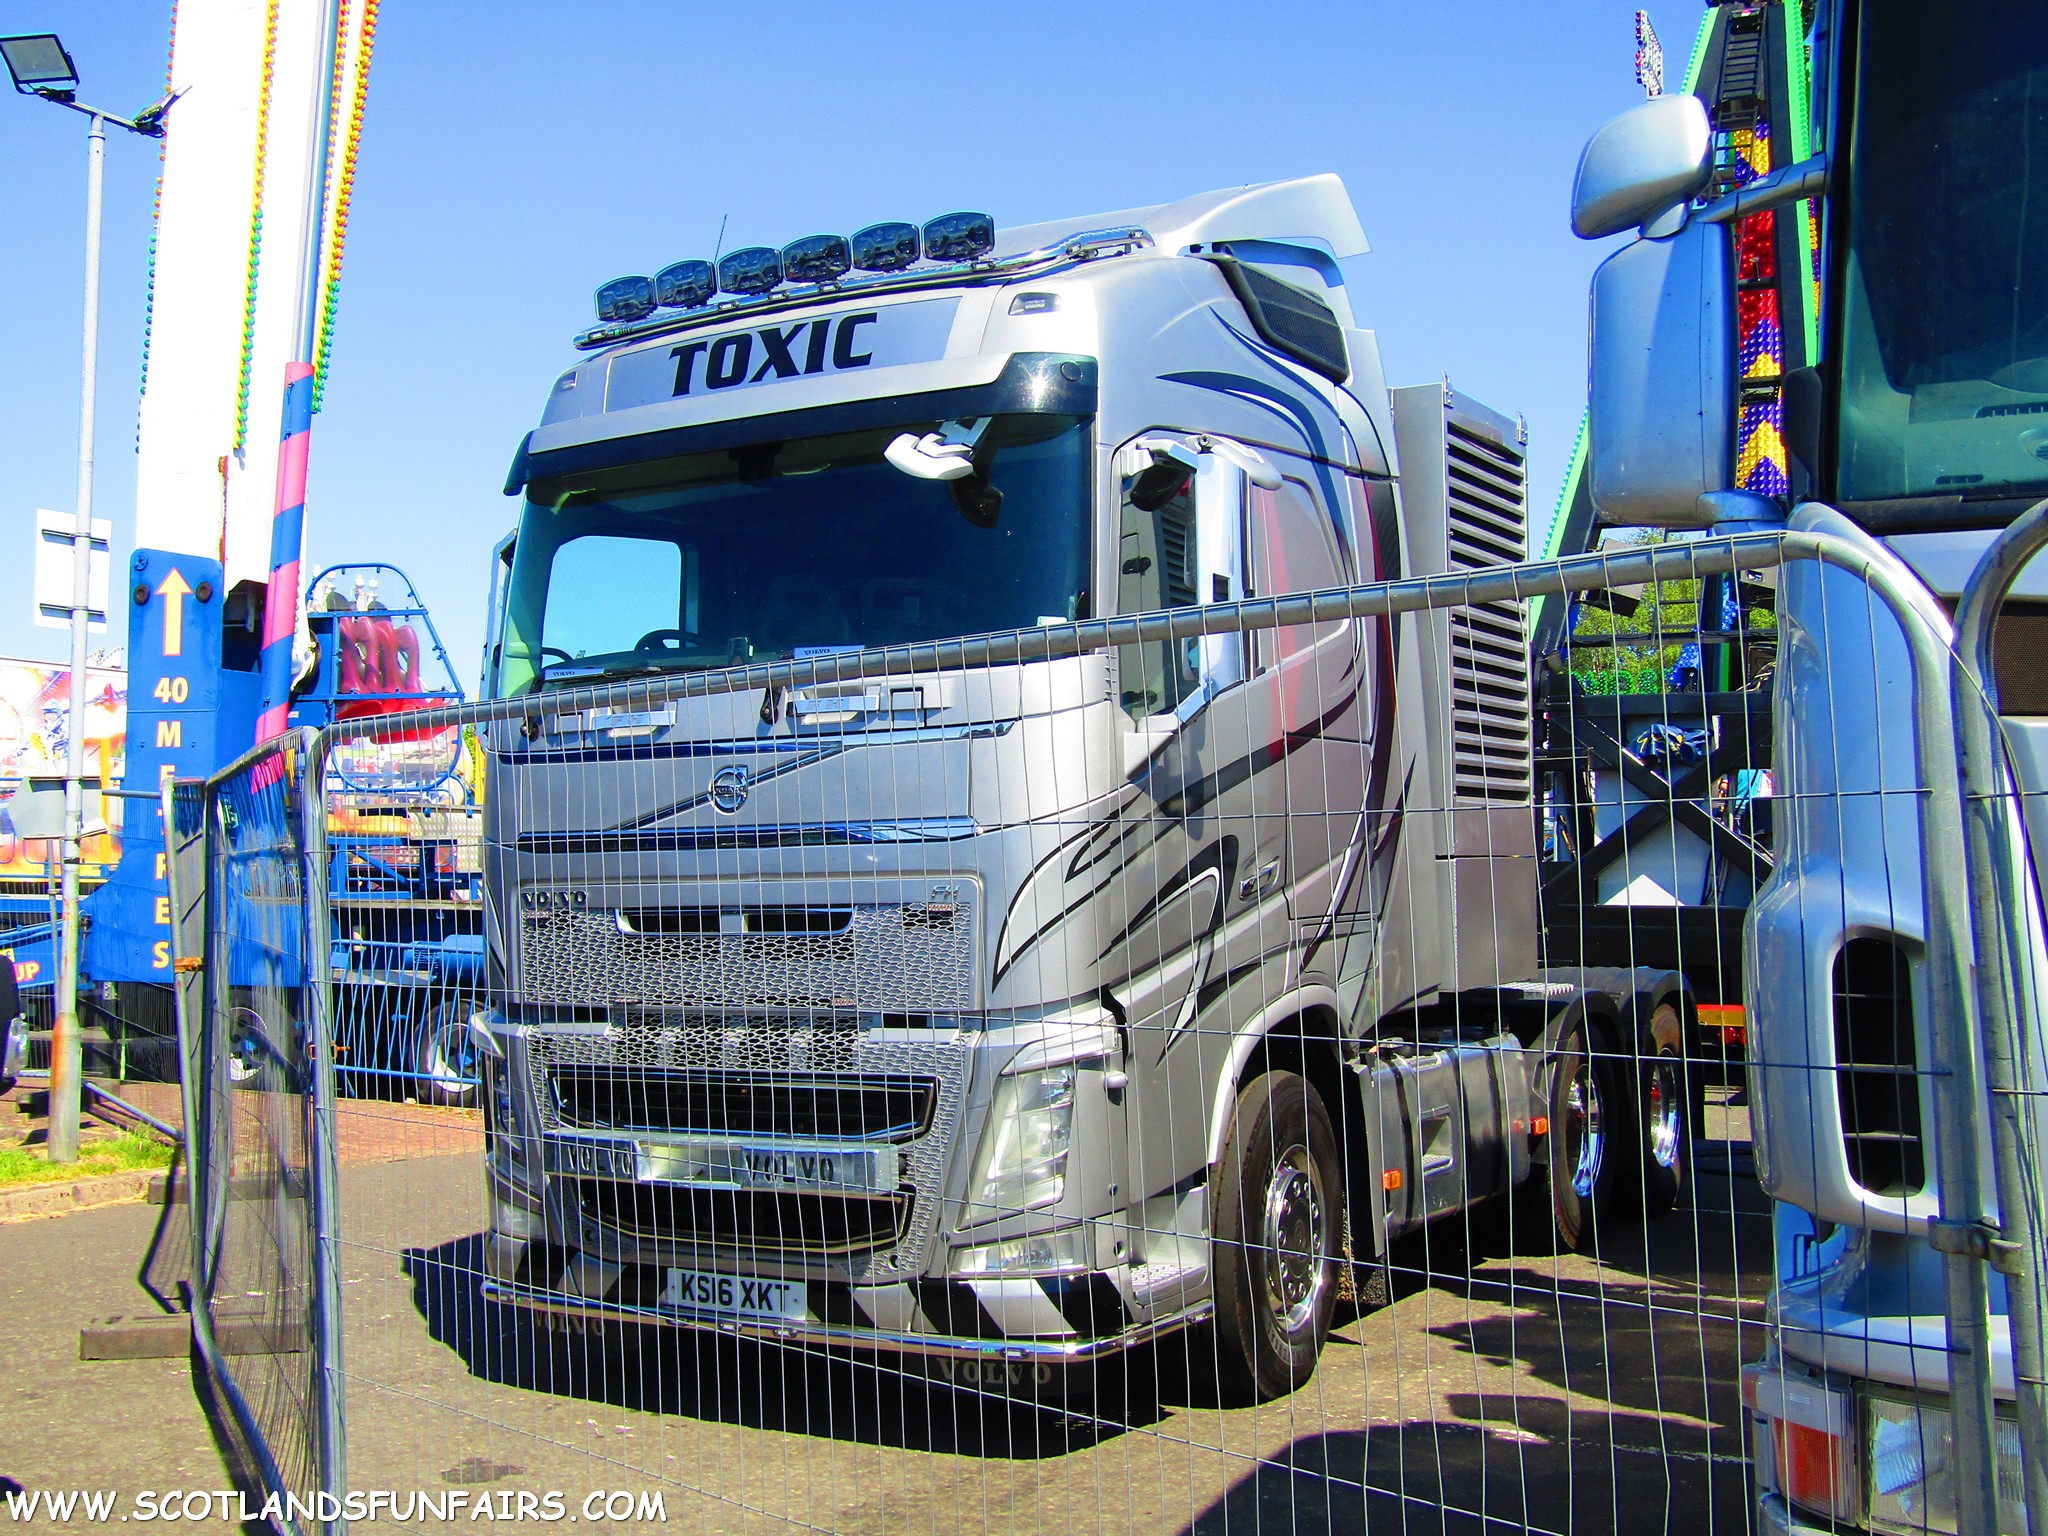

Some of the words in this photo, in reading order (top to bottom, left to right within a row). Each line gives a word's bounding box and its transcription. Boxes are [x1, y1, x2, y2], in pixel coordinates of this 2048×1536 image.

[669, 312, 878, 398] TOXIC
[803, 648, 831, 656] VOLVO
[153, 676, 189, 704] 40
[521, 890, 588, 907] VOLVO
[567, 1144, 633, 1175] VOLVO
[744, 1154, 835, 1183] VOLVO
[681, 1272, 733, 1306] KS16
[740, 1280, 790, 1312] XKT
[534, 1310, 607, 1336] VOLVO
[938, 1359, 1052, 1385] VOLVO
